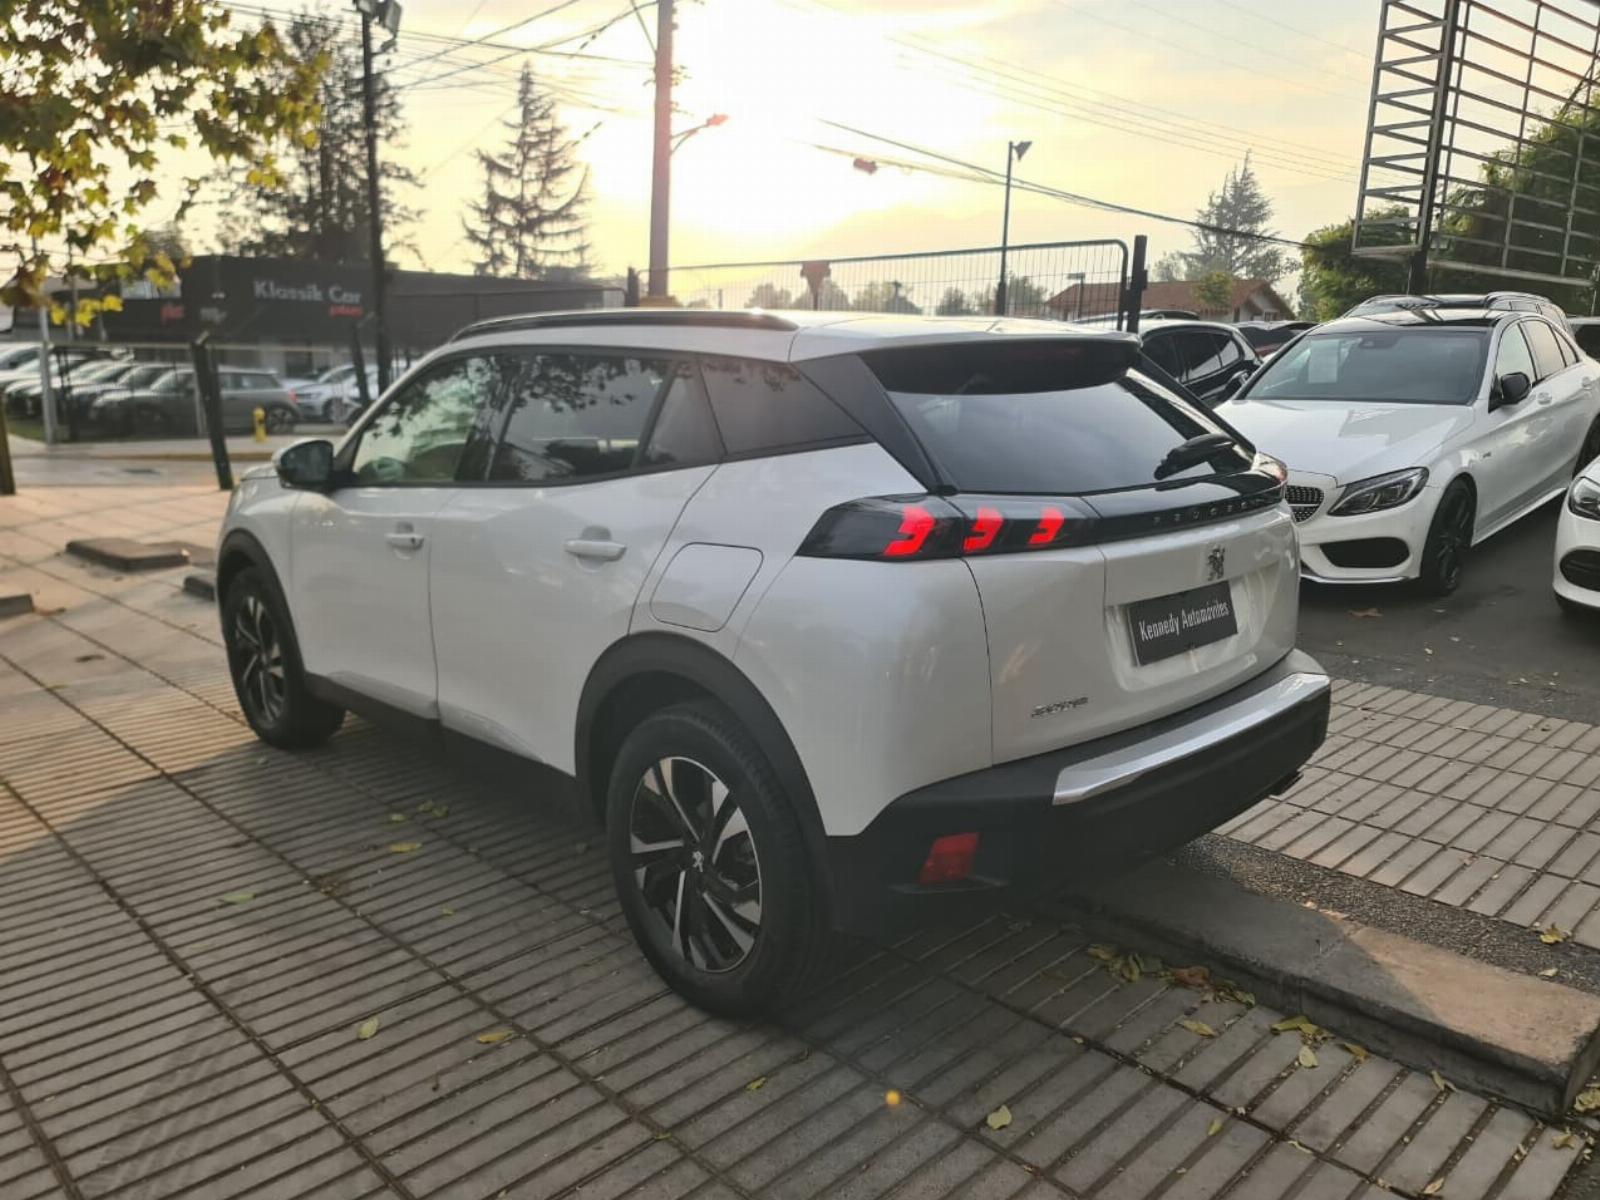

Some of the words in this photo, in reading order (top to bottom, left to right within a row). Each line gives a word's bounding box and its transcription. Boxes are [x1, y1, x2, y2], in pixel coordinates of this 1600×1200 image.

[254, 280, 323, 302] Klassik
[329, 285, 361, 304] Car
[1139, 612, 1180, 642] Kennedy
